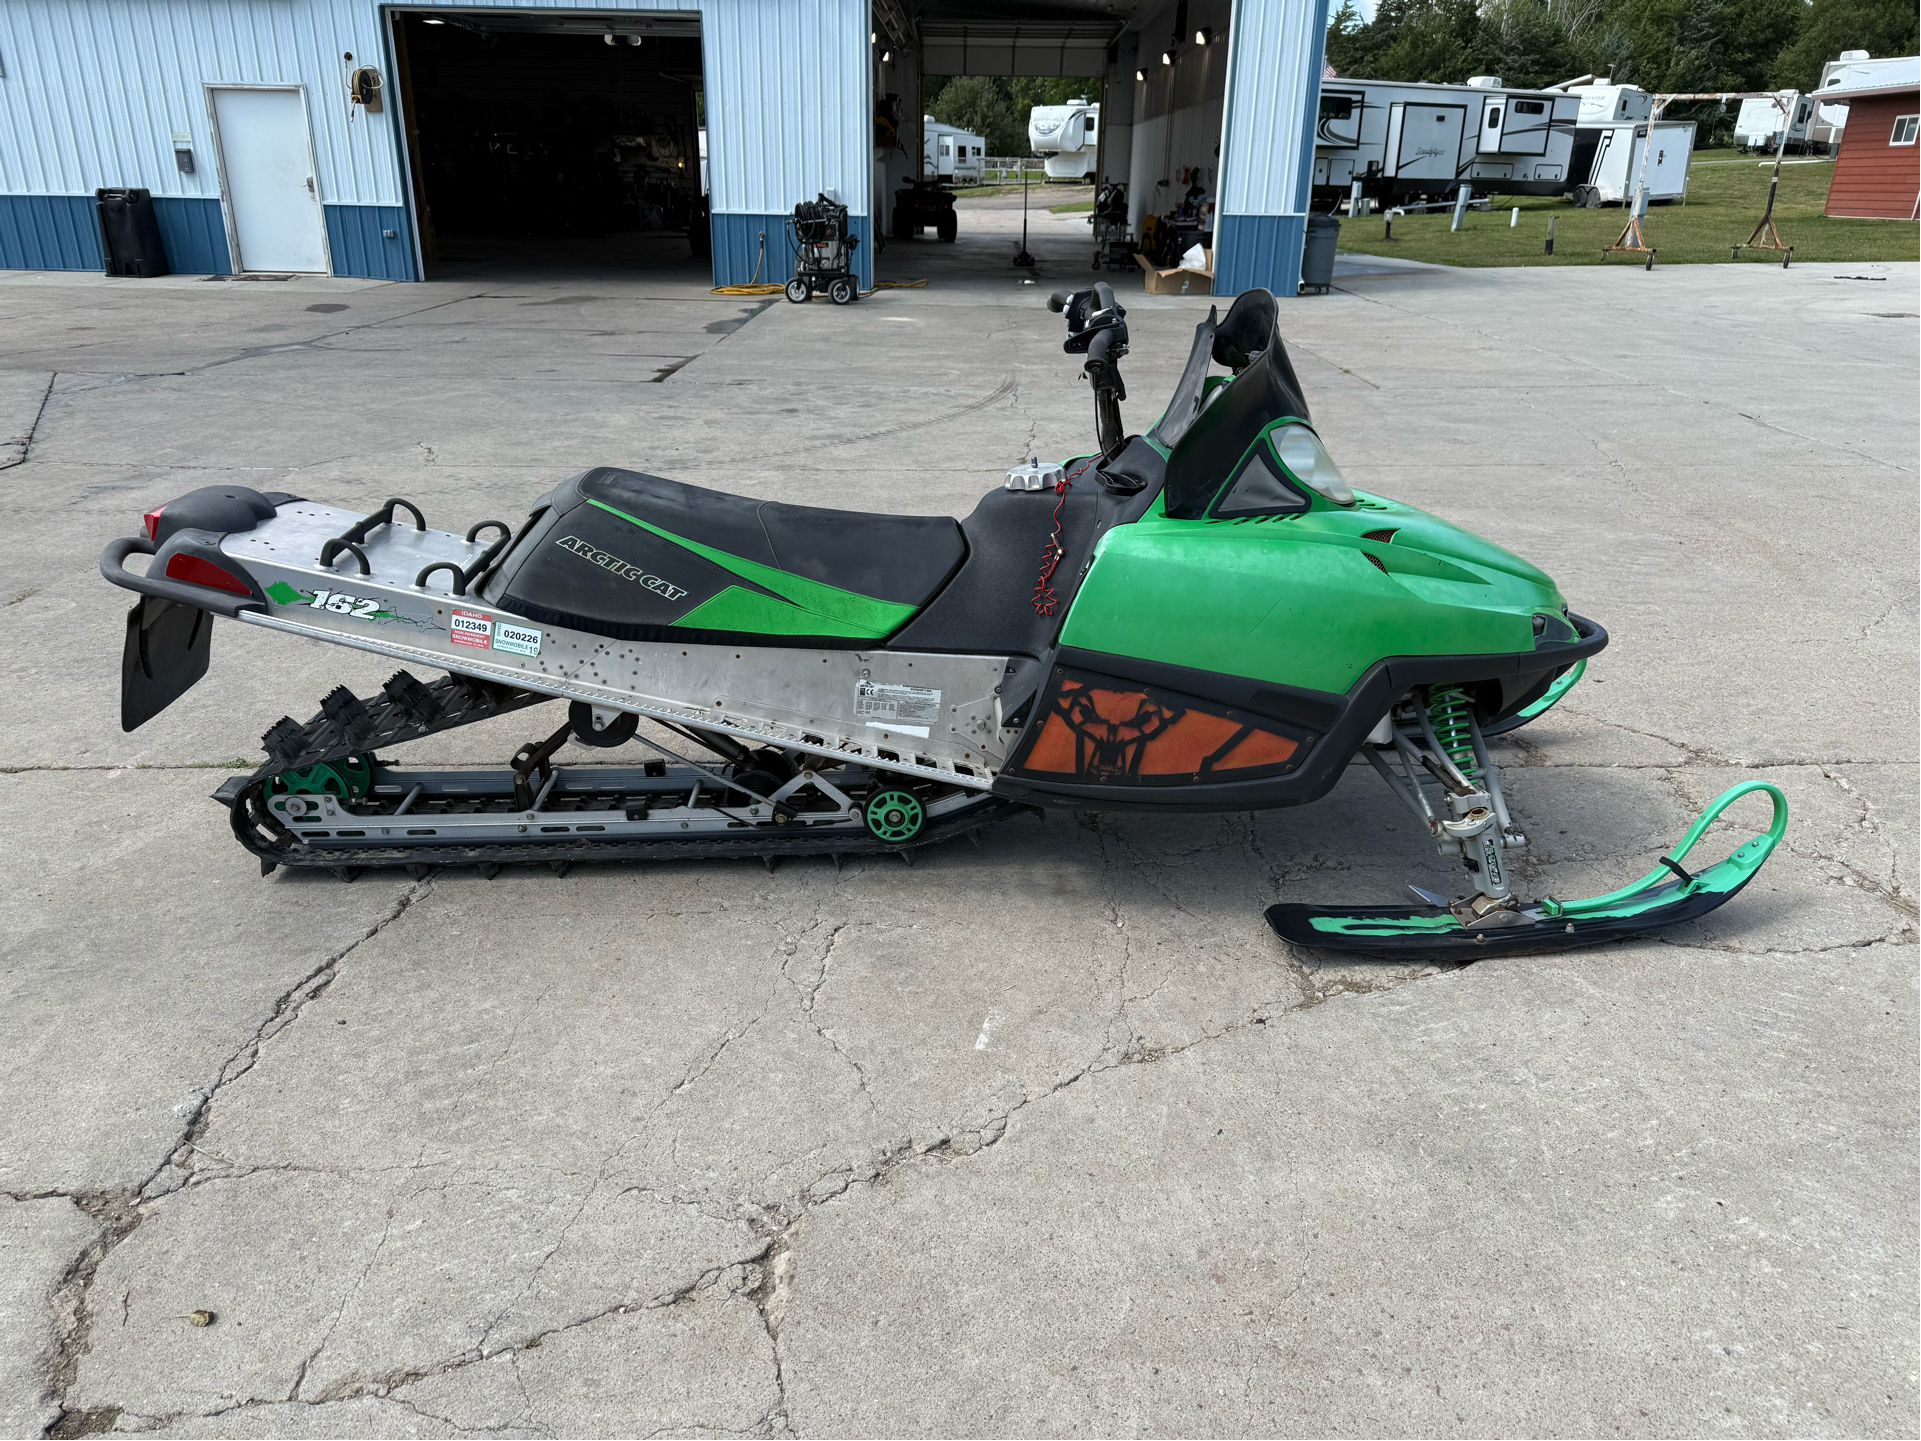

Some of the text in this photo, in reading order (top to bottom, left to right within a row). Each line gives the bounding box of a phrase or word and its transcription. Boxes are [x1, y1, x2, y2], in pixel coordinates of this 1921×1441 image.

[555, 535, 687, 601] ARCTIC CAT
[309, 590, 380, 620] 162
[461, 610, 483, 619] IDAHO
[454, 618, 487, 632] 012349
[452, 633, 487, 644] SNOWMOBILE
[504, 629, 538, 643] 020226
[495, 638, 529, 650] SNOWMOBILE
